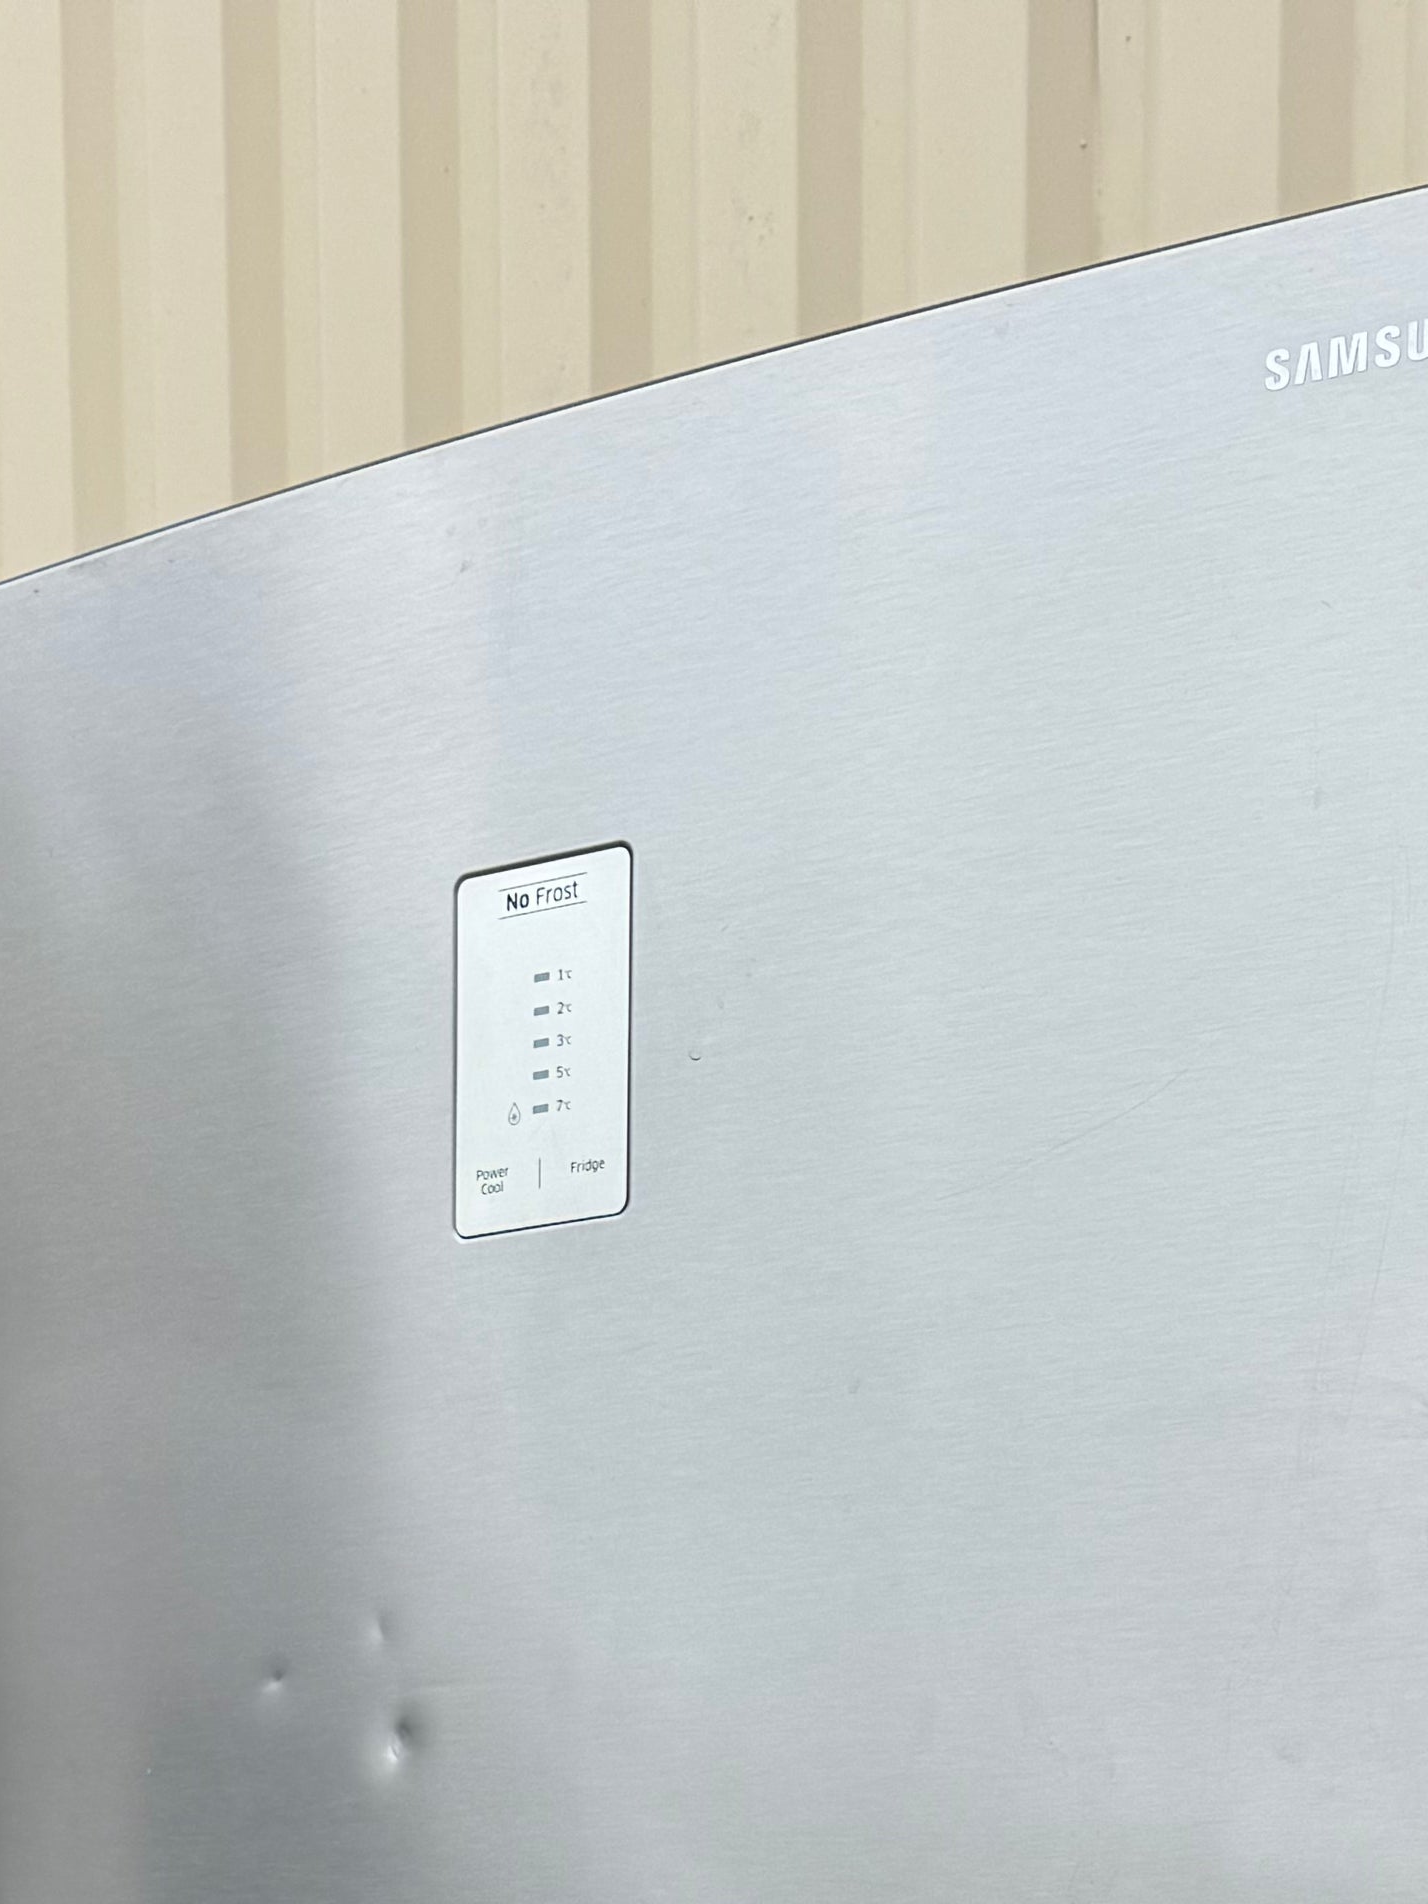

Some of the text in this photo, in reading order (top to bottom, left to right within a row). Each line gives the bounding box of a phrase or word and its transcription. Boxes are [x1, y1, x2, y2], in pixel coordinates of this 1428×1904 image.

[506, 880, 578, 912] No Frost
[570, 1159, 605, 1173] Fridge
[476, 1167, 509, 1181] Power
[481, 1181, 504, 1195] Cool
